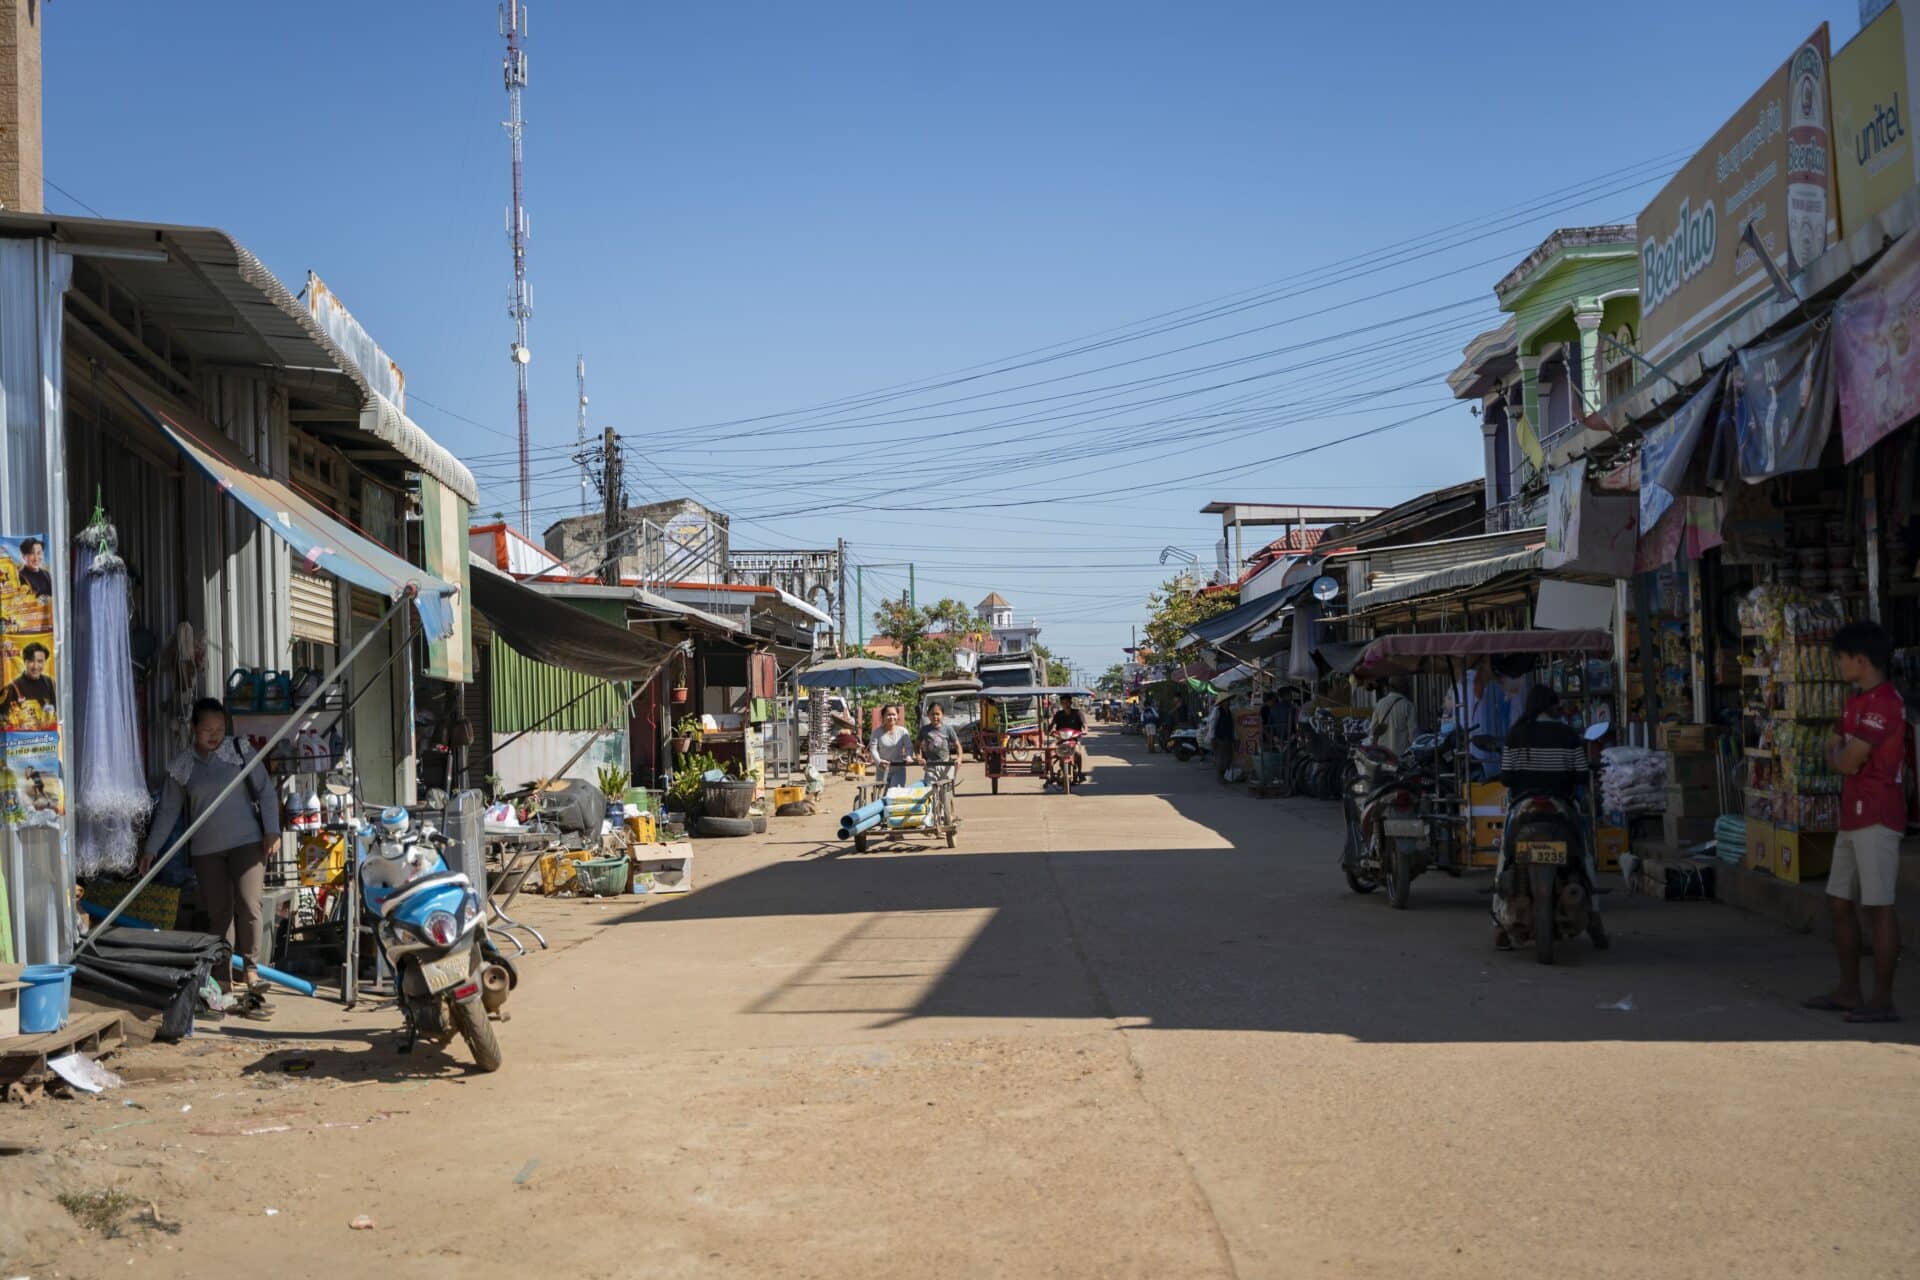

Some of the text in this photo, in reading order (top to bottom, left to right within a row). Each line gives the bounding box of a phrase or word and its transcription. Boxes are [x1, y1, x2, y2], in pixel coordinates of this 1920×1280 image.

[1788, 136, 1825, 175] Beerlao
[1856, 91, 1904, 166] unitel
[1643, 199, 1714, 312] Beerlao
